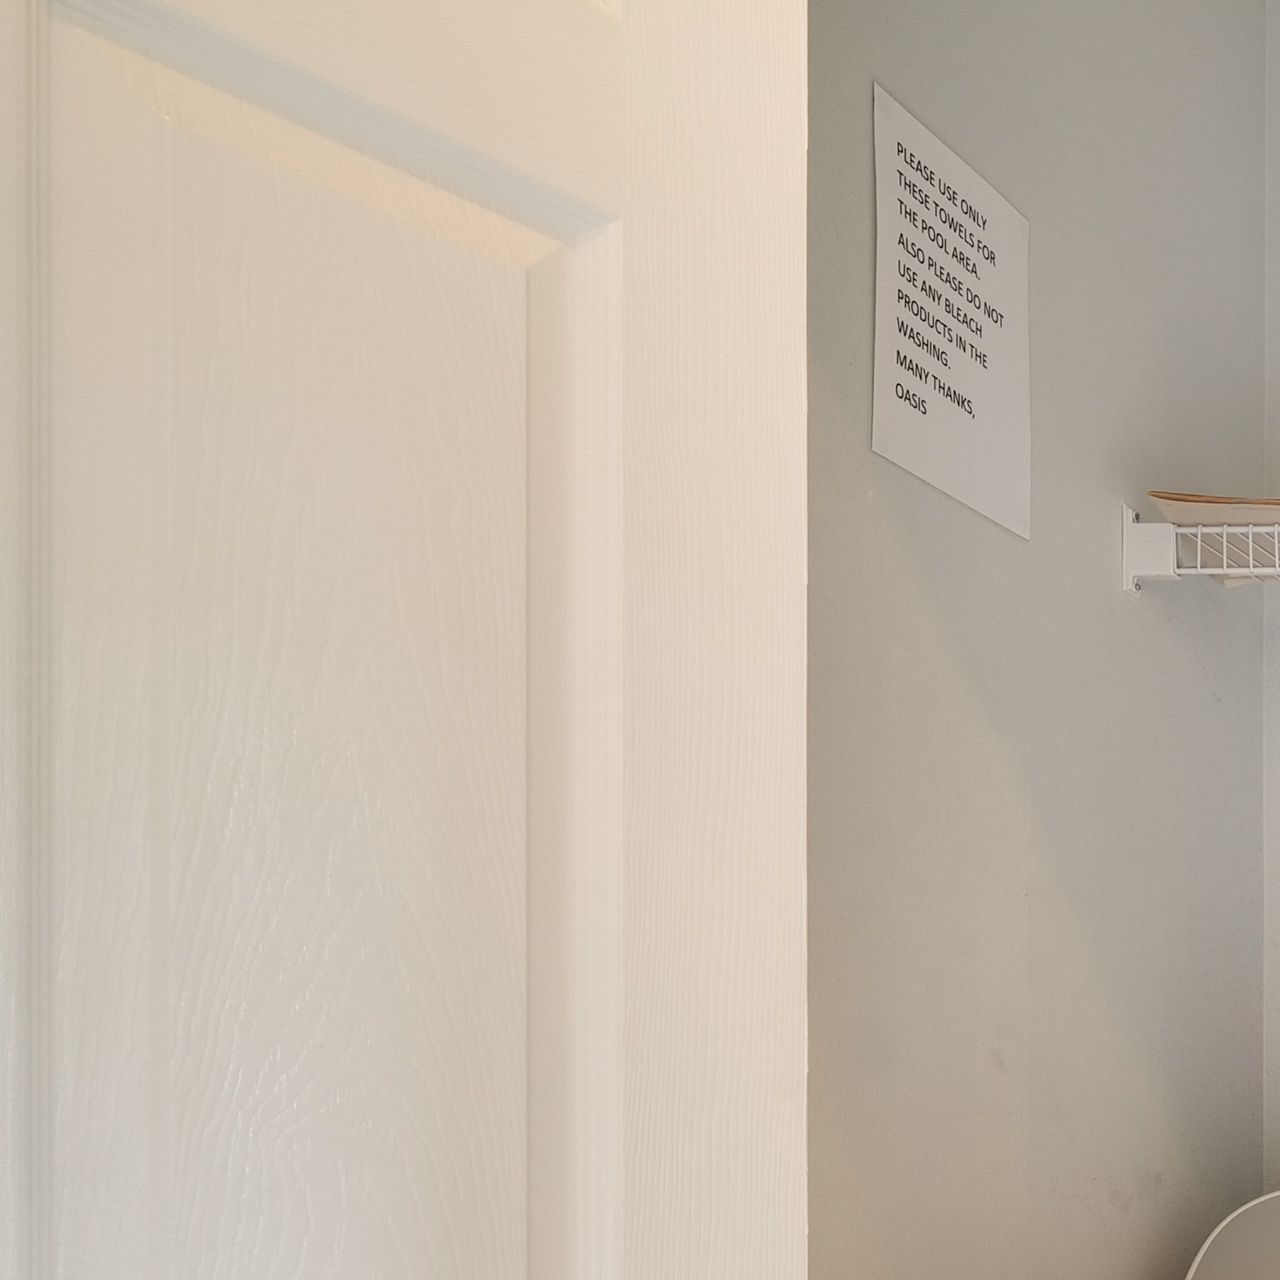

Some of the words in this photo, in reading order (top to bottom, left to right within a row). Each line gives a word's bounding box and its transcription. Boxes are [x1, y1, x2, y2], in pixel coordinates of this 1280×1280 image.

[897, 142, 935, 187] PLEASE
[938, 178, 958, 207] USE
[961, 199, 987, 231] ONLY
[897, 169, 930, 211] THESE
[933, 201, 974, 248] TOWELS
[977, 240, 996, 267] FOR
[897, 198, 918, 228] THE
[921, 220, 949, 255] POOL
[952, 247, 980, 280] AREA.
[898, 233, 925, 264] ALSO
[928, 256, 963, 297] PLEASE
[966, 287, 981, 310] DO
[984, 301, 1004, 328] NOT
[898, 260, 918, 288] USE
[920, 280, 942, 306] ANY
[945, 298, 982, 338] BLEACH
[897, 289, 953, 343] PRODUCTS
[956, 333, 966, 353] IN
[969, 343, 988, 369] THE
[897, 316, 951, 370] WASHING.
[895, 382, 927, 415] OASIS
[896, 350, 929, 384] MANY
[932, 374, 975, 419] THANKS,
